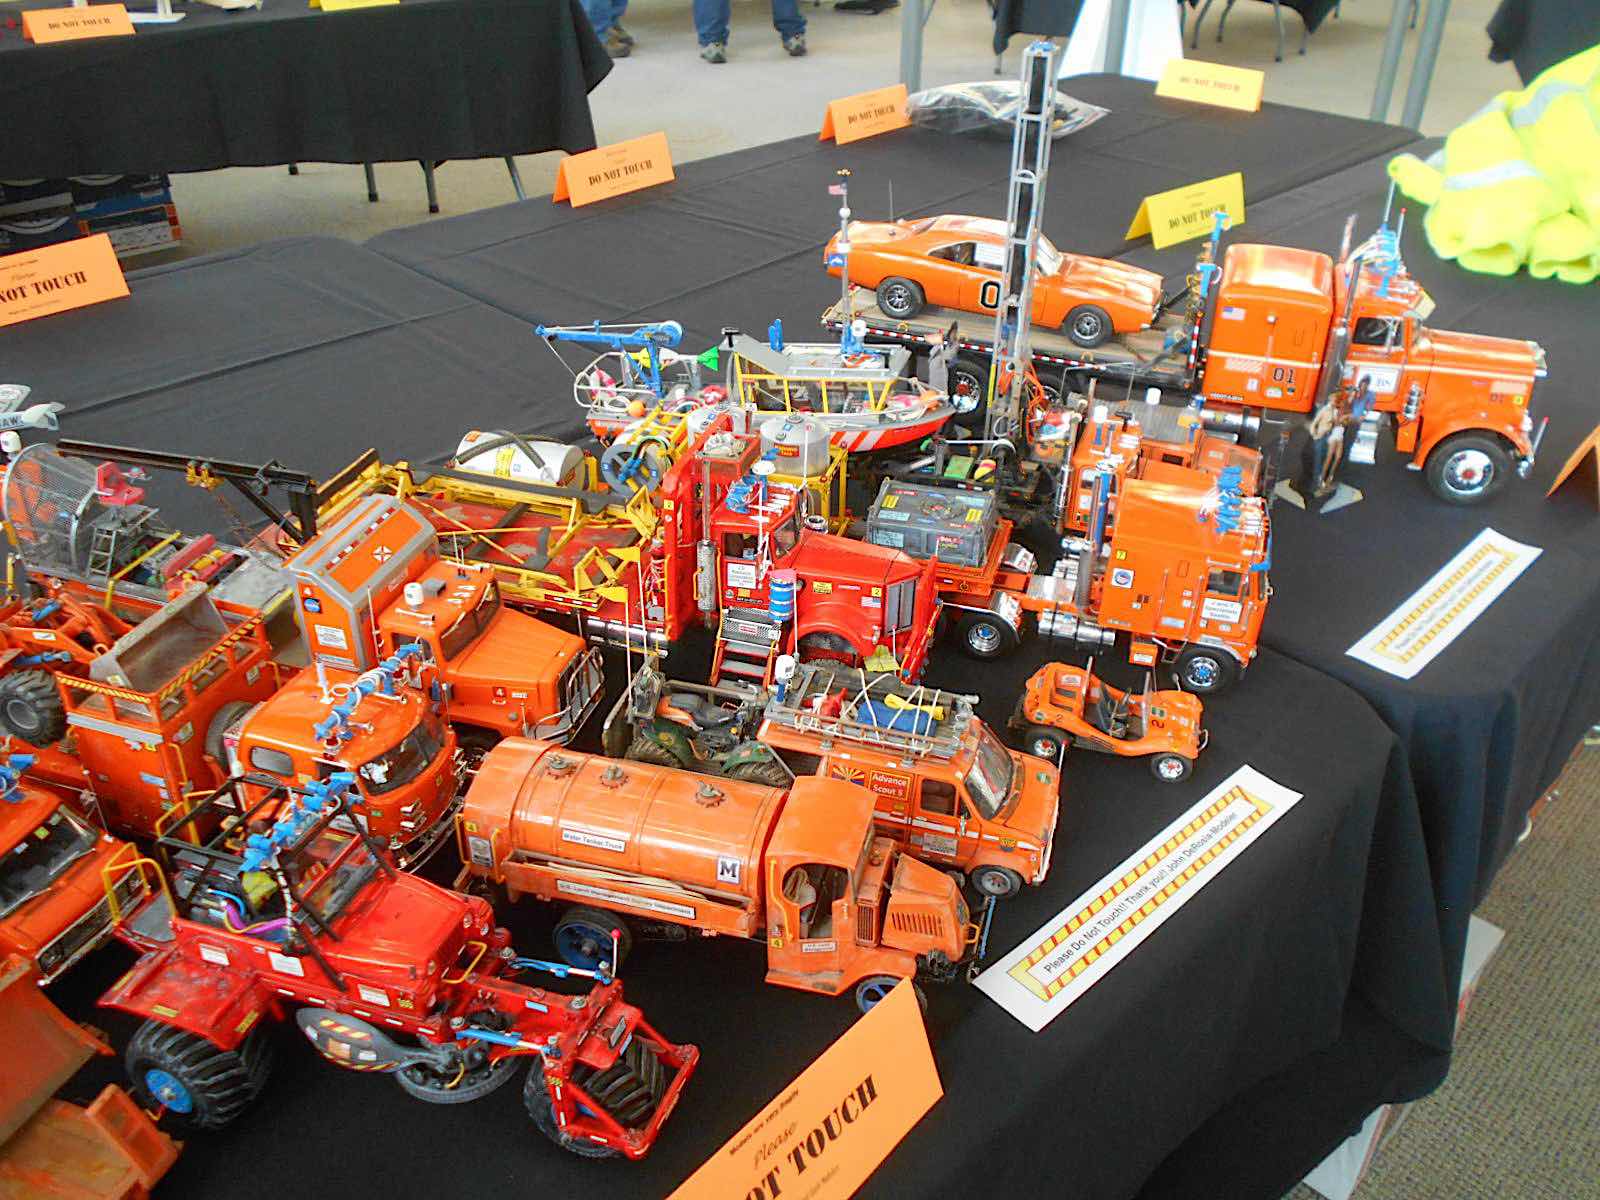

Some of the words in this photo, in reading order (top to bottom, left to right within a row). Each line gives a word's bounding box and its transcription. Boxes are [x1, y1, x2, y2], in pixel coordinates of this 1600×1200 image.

[588, 174, 602, 186] DO
[603, 169, 621, 181] NOT
[624, 159, 653, 177] TOUCH
[1168, 218, 1180, 229] DO
[1182, 212, 1198, 225] NOT
[31, 271, 88, 295] TOUCH
[1273, 367, 1295, 385] 01
[872, 773, 907, 786] Advance
[872, 784, 896, 795] Scout
[719, 860, 739, 879] M
[1043, 948, 1074, 973] Please
[1071, 939, 1086, 951] Do
[1083, 925, 1101, 941] Not
[1124, 884, 1151, 905] Thank
[1167, 856, 1185, 872] John
[787, 1073, 879, 1177] TOUCH
[754, 1121, 798, 1170] Please
